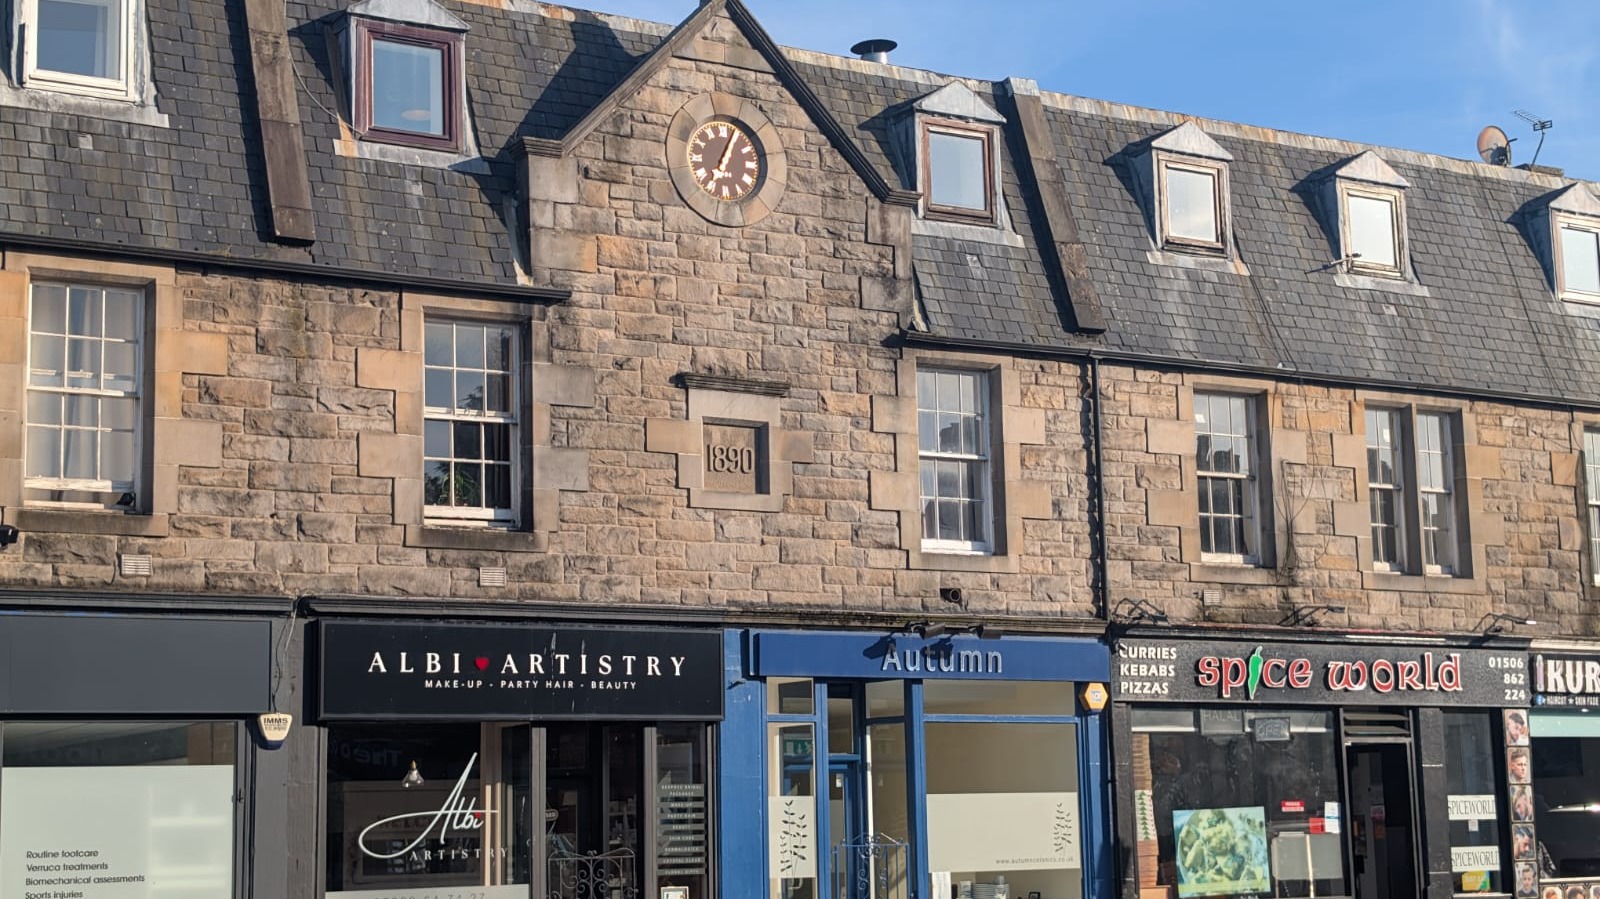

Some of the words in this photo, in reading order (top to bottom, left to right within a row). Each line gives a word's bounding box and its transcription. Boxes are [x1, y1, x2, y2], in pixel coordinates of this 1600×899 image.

[707, 444, 754, 474] 1890
[882, 643, 1002, 673] Autumn
[1119, 646, 1177, 660] CURRIES
[368, 651, 461, 673] ALBI
[500, 653, 685, 677] ARTISTRY
[1488, 656, 1524, 669] 01506
[1120, 663, 1175, 677] KEBABS
[424, 679, 483, 689] MAKE-UP
[500, 680, 539, 689] PARTY
[545, 680, 574, 689] HAIR
[591, 681, 637, 690] BEAUTY
[1503, 673, 1525, 684] 862
[1120, 681, 1169, 694] PIZZAS
[1504, 689, 1526, 700] 224
[1203, 709, 1240, 722] HALAL
[26, 850, 60, 859] Routine
[61, 849, 99, 858] footcare
[410, 848, 507, 861] ARTISTRY
[26, 863, 61, 872] Verruca
[63, 862, 109, 871] treatments
[25, 876, 91, 886] Biomechanical
[93, 874, 145, 884] assessments
[25, 891, 52, 899] Sports
[53, 890, 83, 899] injuries
